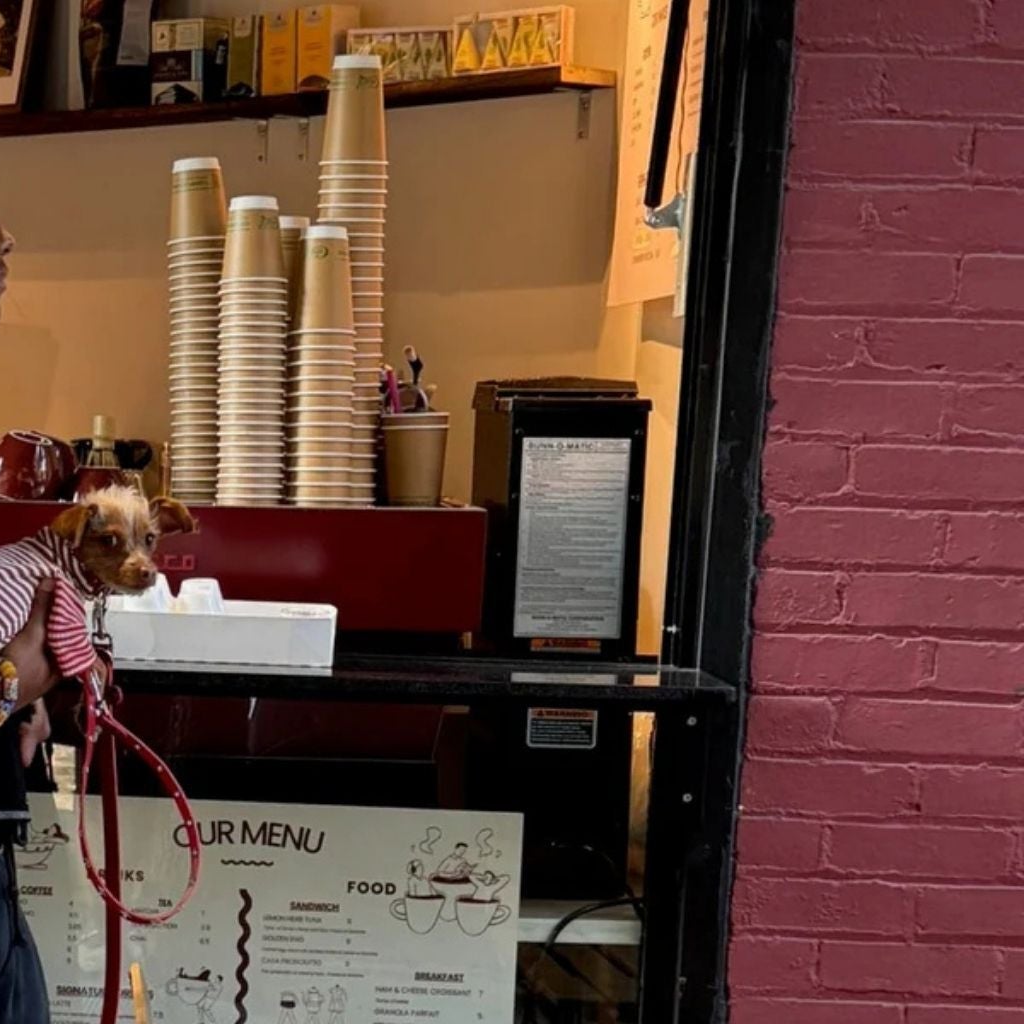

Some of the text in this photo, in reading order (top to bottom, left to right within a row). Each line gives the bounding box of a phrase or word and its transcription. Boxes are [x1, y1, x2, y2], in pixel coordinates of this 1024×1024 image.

[173, 820, 325, 854] OUR MENU
[20, 885, 53, 896] COFFEE
[347, 881, 397, 895] FOOD
[290, 901, 340, 912] SANDWICH
[414, 972, 464, 983] BREAKFAST
[56, 985, 105, 998] SIGNATU
[401, 987, 428, 995] CHEESE
[430, 988, 471, 996] CROISSANT
[374, 1008, 409, 1016] GRANOLA
[410, 1009, 440, 1018] PARFAIT
